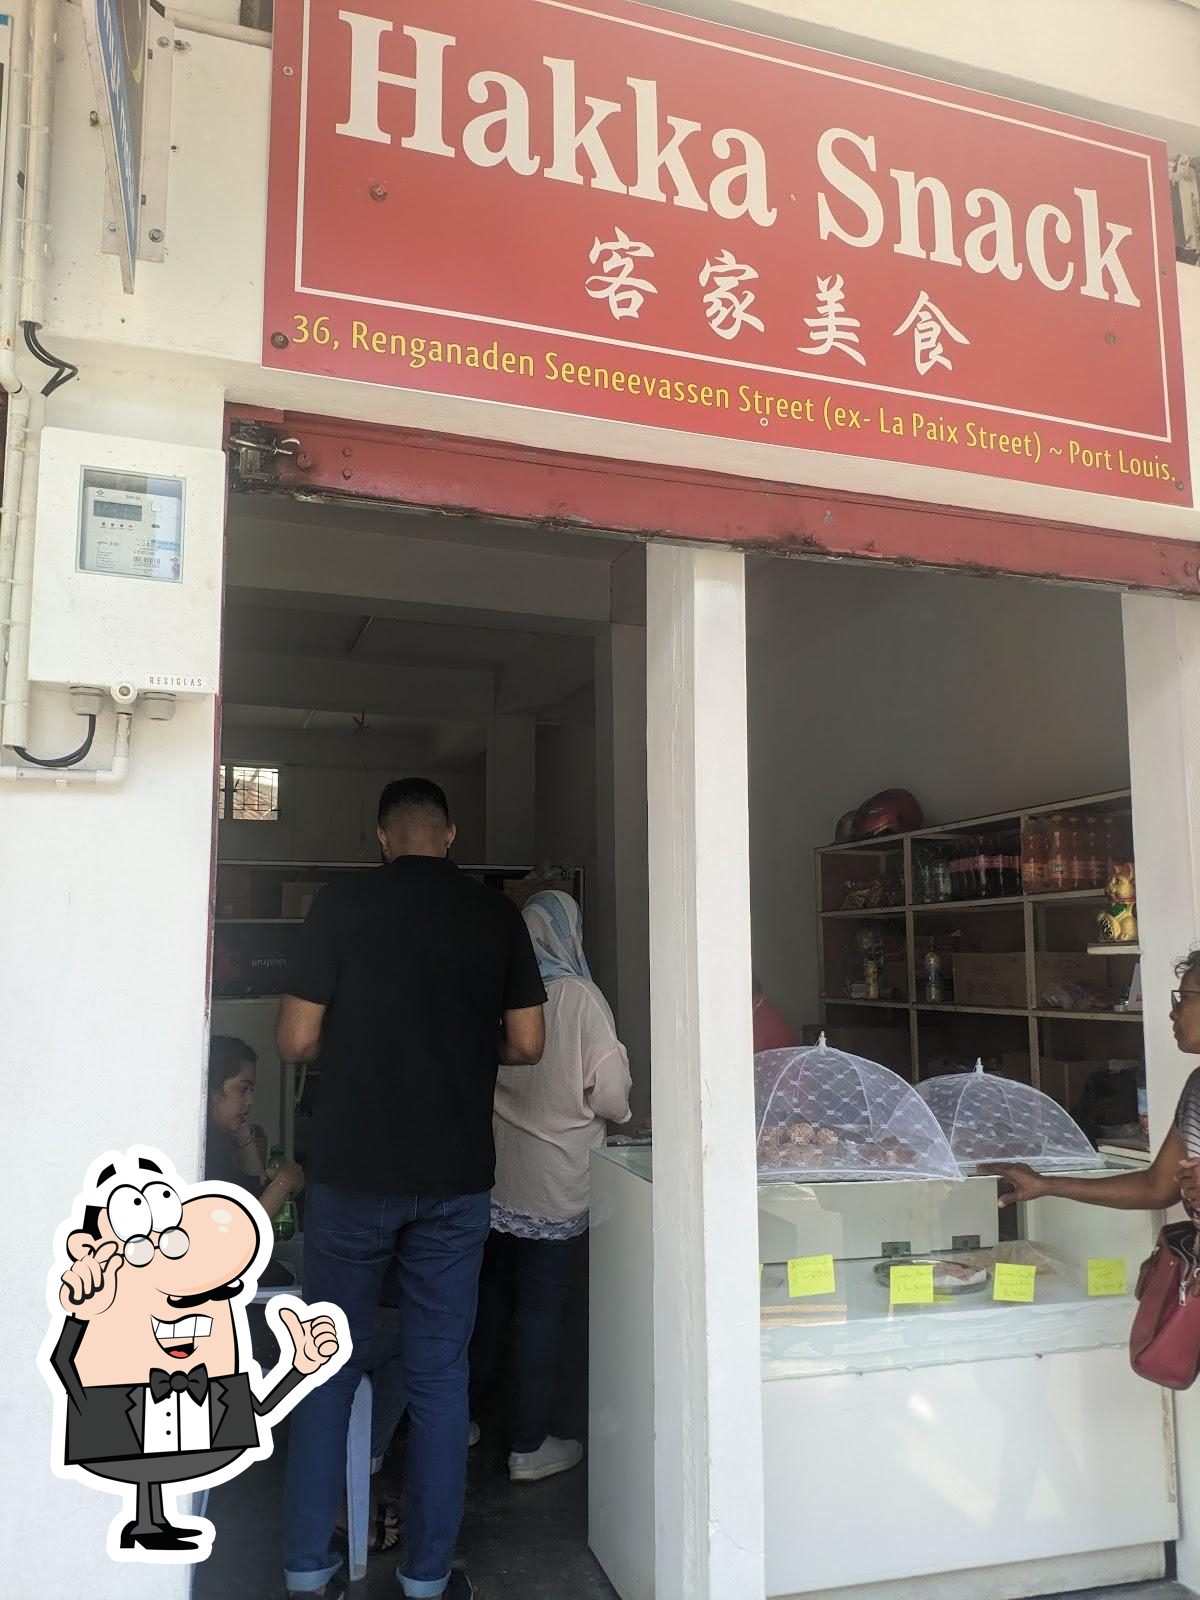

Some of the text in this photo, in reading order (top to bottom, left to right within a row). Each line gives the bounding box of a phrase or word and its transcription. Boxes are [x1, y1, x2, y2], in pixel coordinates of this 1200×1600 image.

[335, 10, 778, 228] Hakka
[816, 127, 1141, 308] Snack
[584, 226, 971, 376] 客家美食
[292, 315, 340, 350] 36,
[351, 320, 534, 376] Renganaden
[544, 352, 730, 409] Seeneevassen
[738, 384, 815, 423] Street
[822, 396, 871, 432] (ex-
[878, 406, 905, 438] La
[911, 412, 959, 445] Paix
[965, 421, 1042, 463] Street)
[1068, 439, 1113, 471] Port
[1118, 449, 1176, 482] Louis.
[149, 676, 203, 687] RESIGLAS
